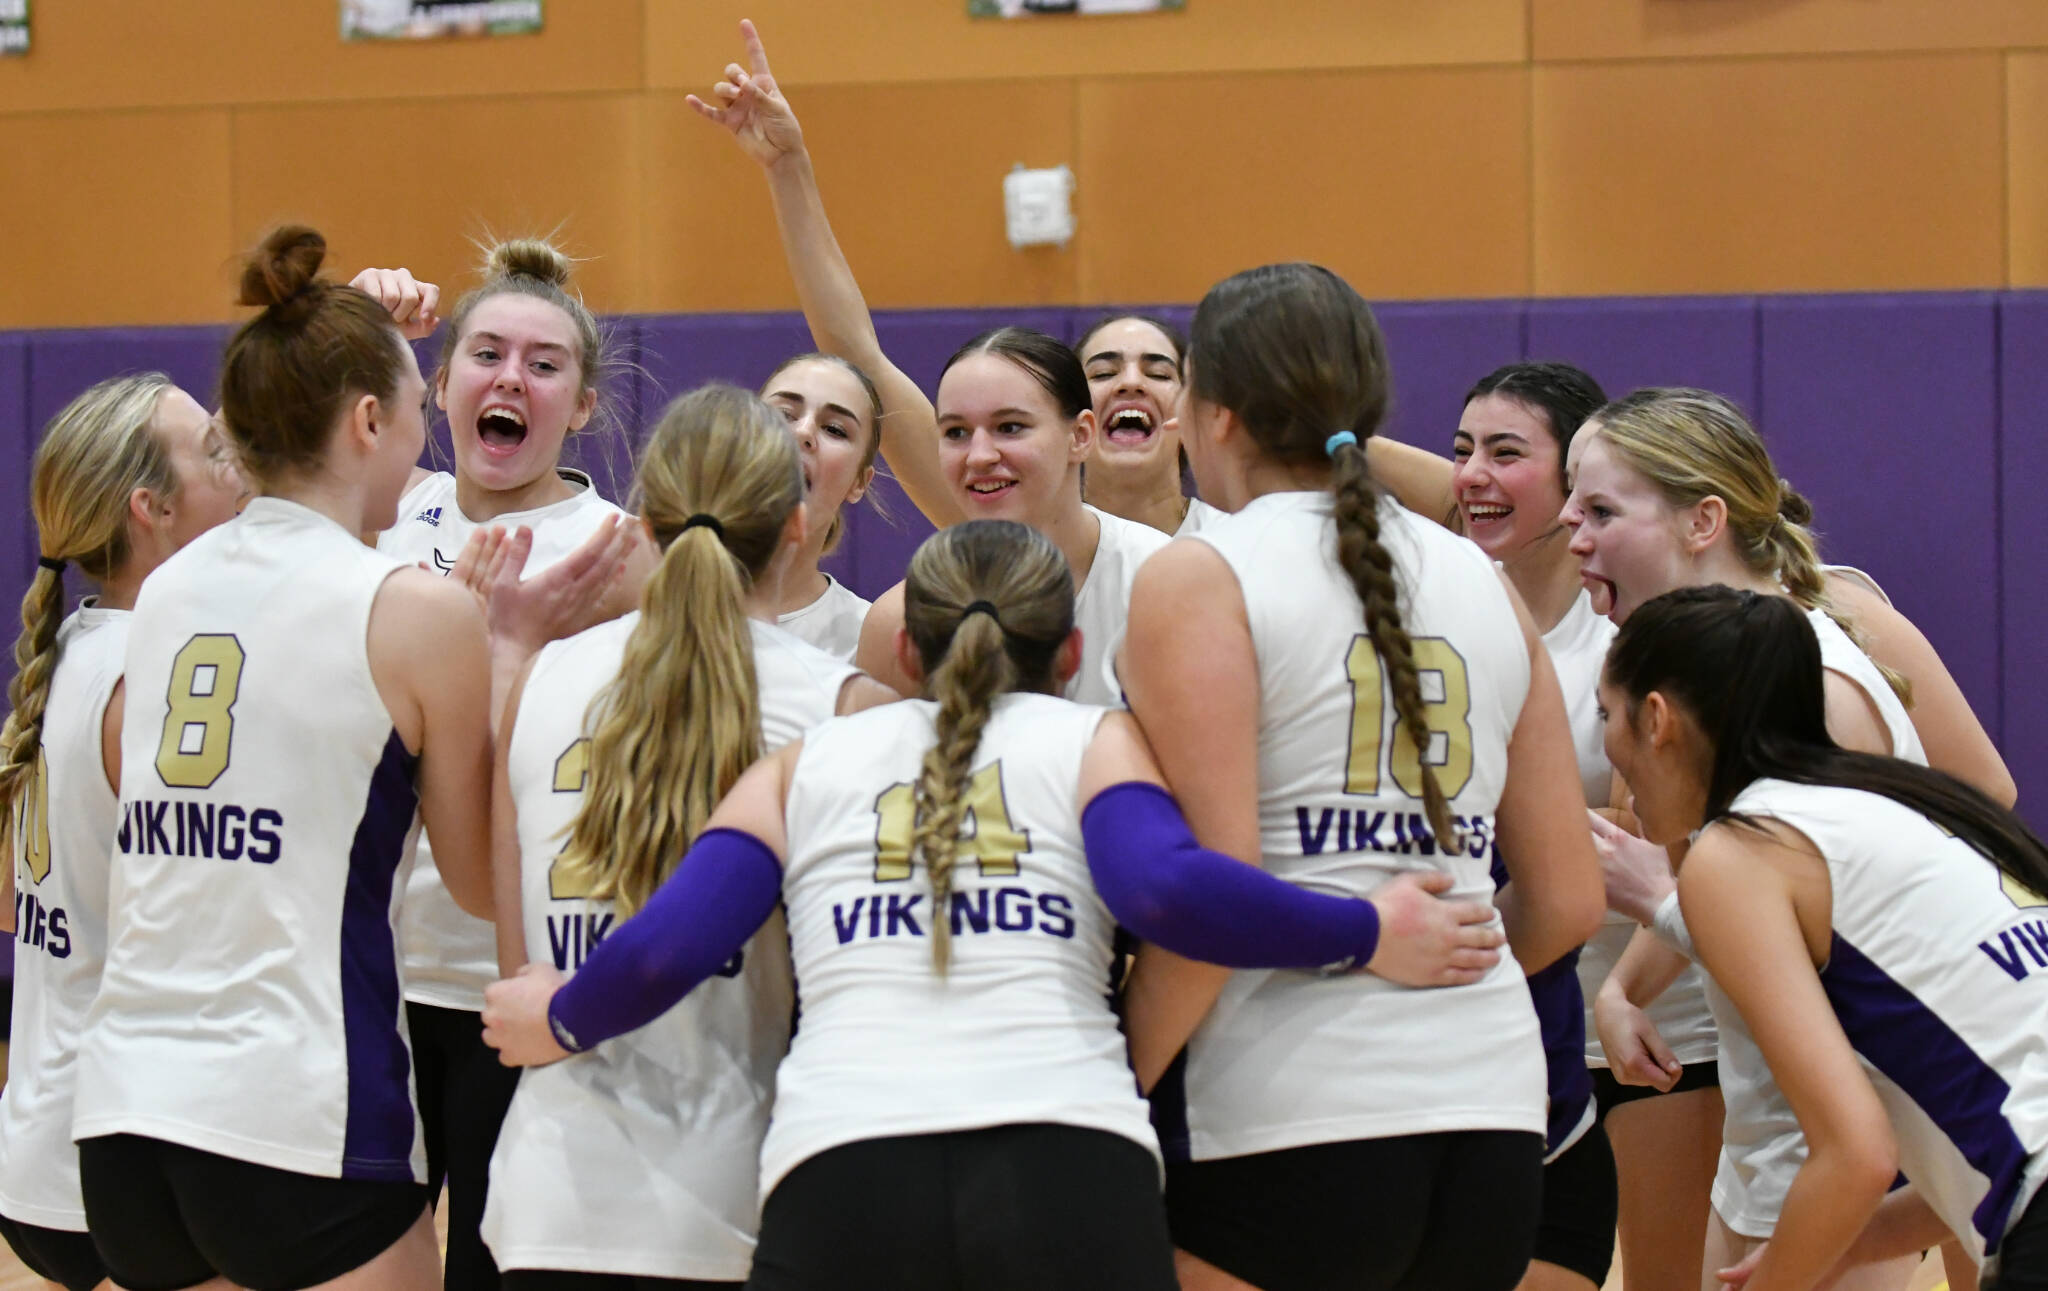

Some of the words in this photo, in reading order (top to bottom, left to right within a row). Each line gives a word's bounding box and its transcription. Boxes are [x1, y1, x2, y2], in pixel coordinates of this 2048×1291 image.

[155, 633, 246, 789] 8
[1343, 633, 1473, 800] 18
[117, 799, 283, 864] VIKINGS
[874, 758, 1032, 883] 14
[833, 887, 1075, 944] VIKNGS
